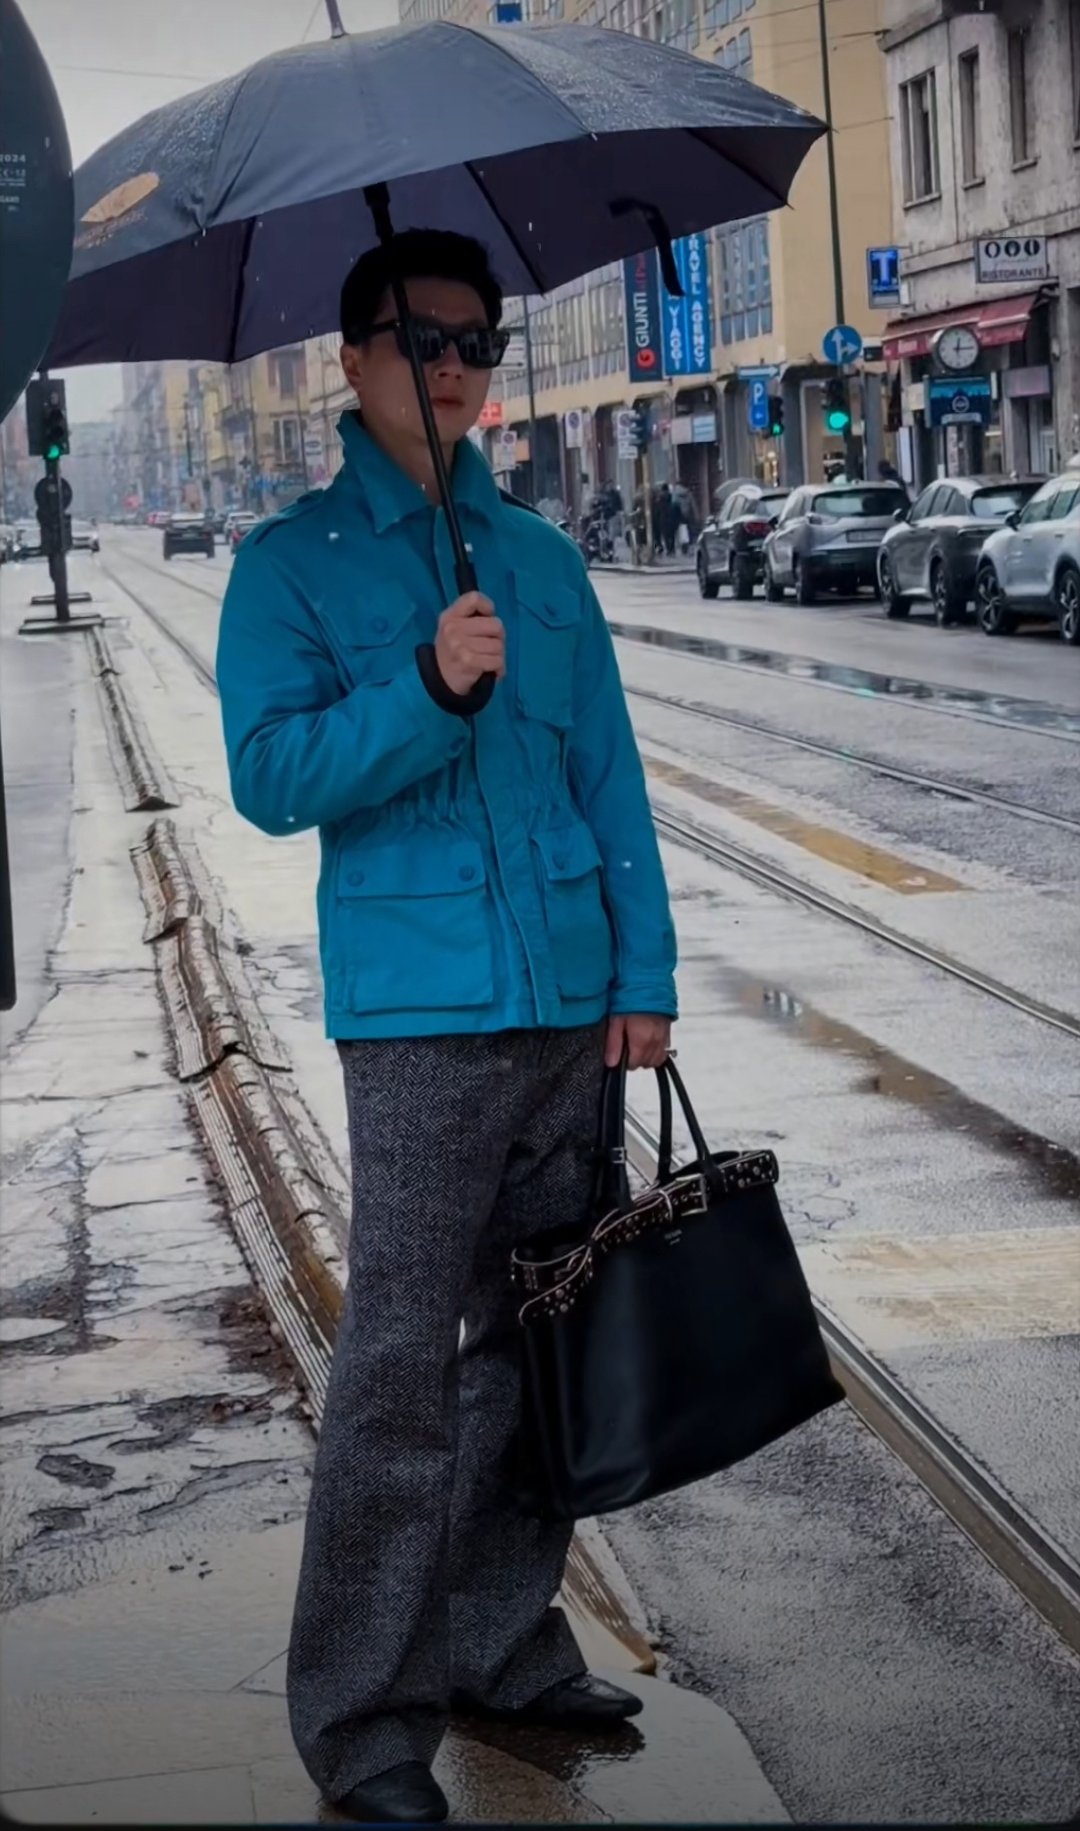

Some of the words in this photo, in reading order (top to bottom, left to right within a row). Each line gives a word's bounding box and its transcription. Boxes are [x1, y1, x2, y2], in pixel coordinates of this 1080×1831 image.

[982, 268, 1045, 279] RISTORANTE
[633, 292, 650, 347] GIUNTI
[691, 301, 705, 367] AGENCY
[754, 382, 763, 405] P
